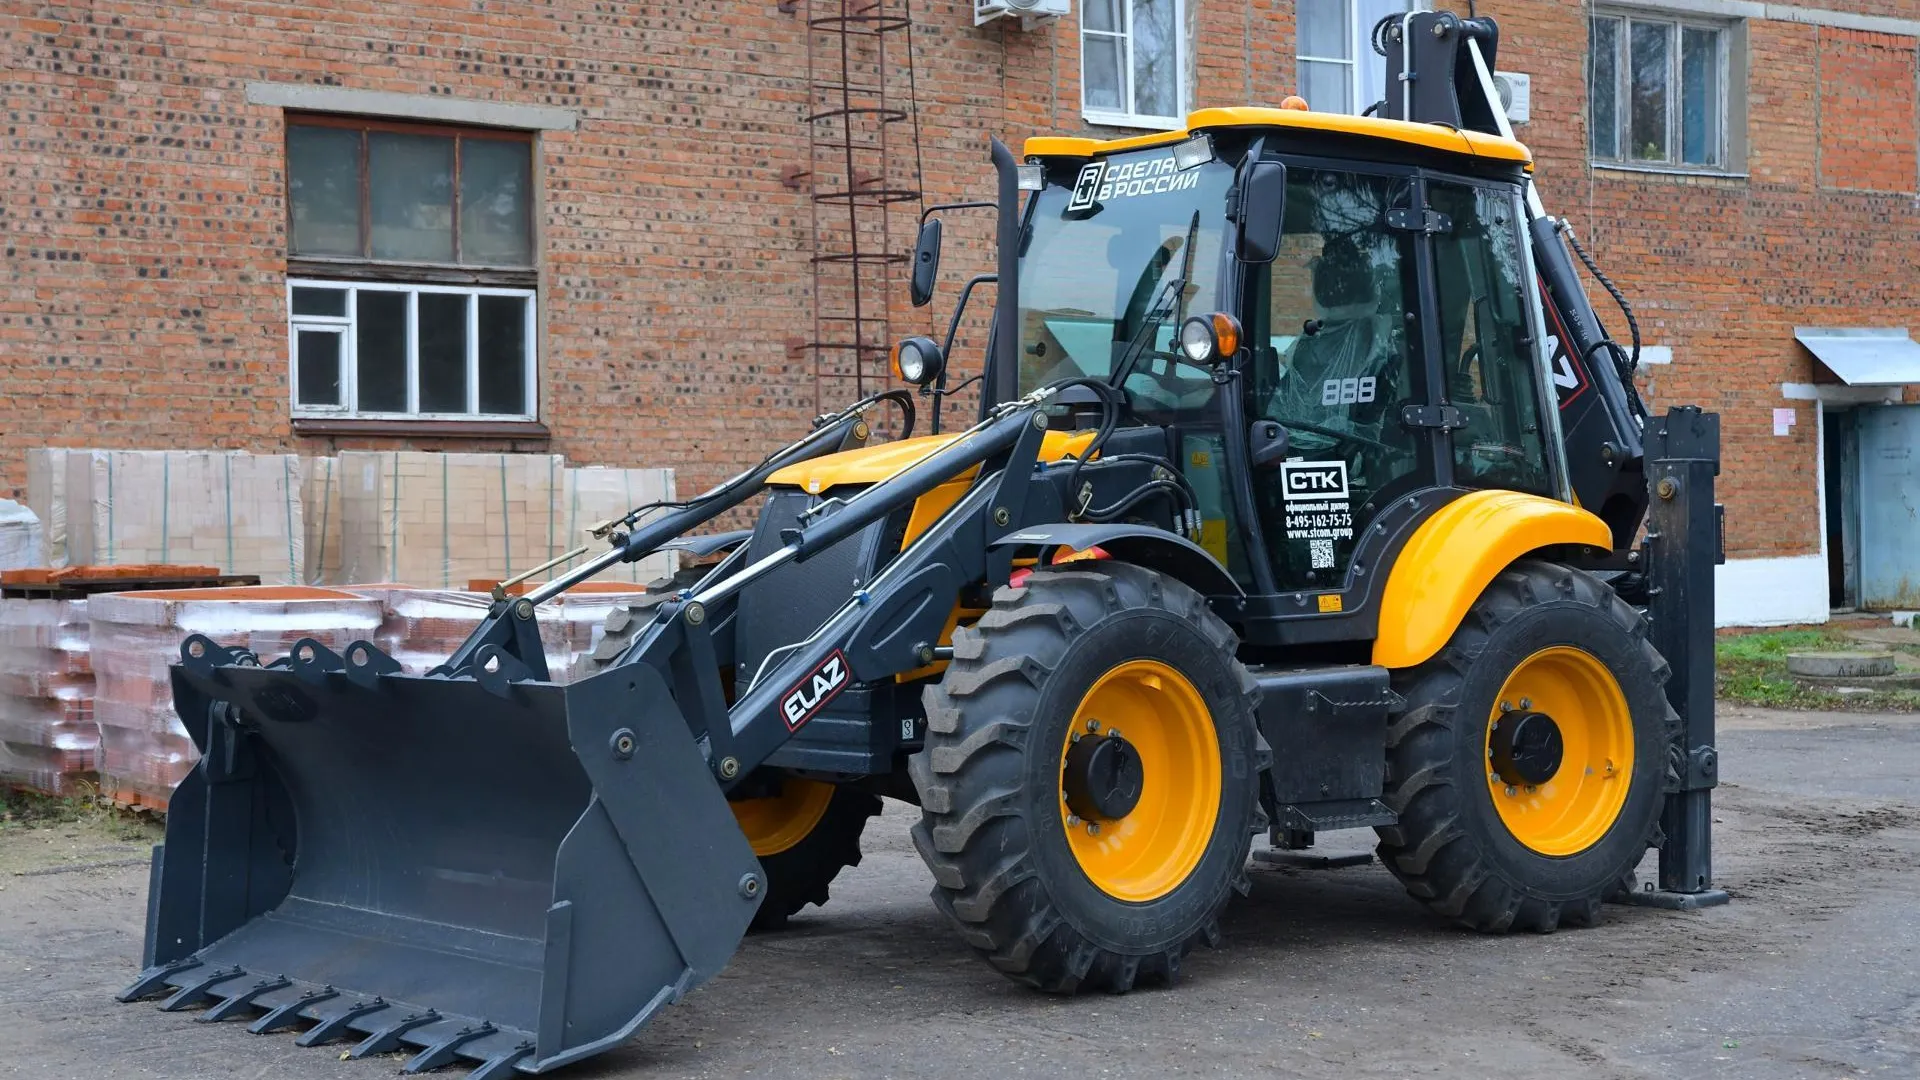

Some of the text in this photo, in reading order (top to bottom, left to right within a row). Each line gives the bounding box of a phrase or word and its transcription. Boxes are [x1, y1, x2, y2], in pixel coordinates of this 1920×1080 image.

[1103, 156, 1201, 183] СДЕЛА
[1113, 171, 1200, 199] РОССИИ
[1321, 376, 1377, 406] 888
[1289, 471, 1340, 490] СТК
[1286, 514, 1352, 527] 8-495-162-75-75
[783, 656, 846, 725] ELAZ
